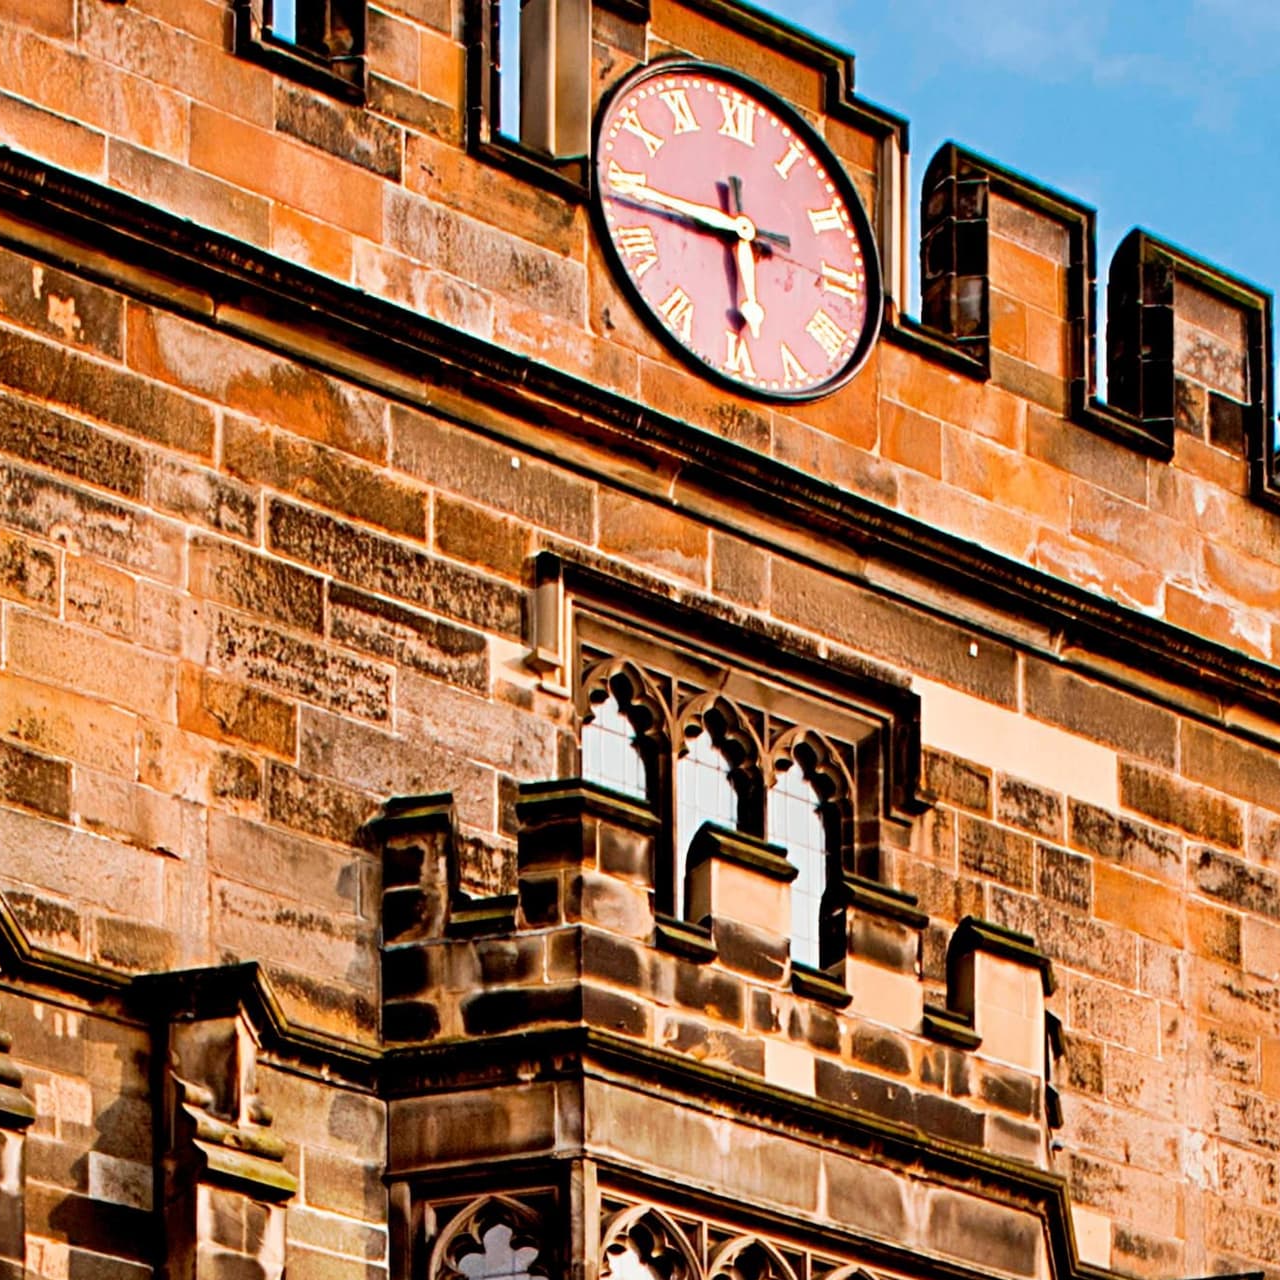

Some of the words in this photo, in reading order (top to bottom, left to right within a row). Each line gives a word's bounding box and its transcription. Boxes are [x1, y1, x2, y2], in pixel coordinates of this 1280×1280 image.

[619, 107, 665, 158] X
[659, 90, 701, 135] XI
[717, 93, 755, 147] XII
[774, 142, 803, 180] I
[807, 204, 845, 234] II
[724, 330, 756, 378] VI
[781, 342, 808, 380] V
